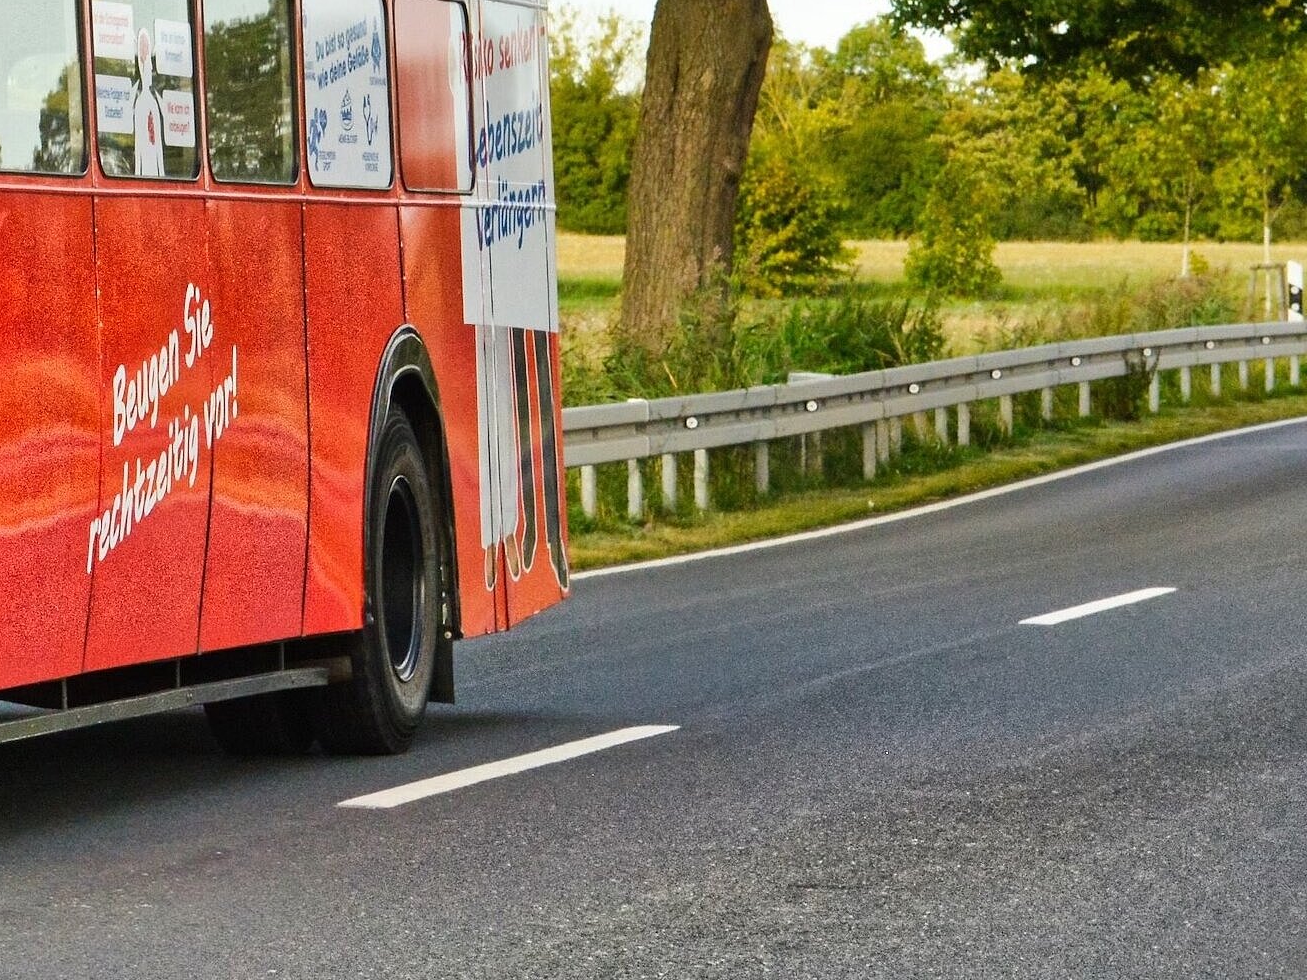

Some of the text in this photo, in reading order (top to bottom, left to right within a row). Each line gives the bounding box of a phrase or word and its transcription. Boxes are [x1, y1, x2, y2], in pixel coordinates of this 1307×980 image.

[329, 60, 347, 84] deine
[499, 14, 537, 71] senken
[112, 281, 214, 447] Beugen Sie
[85, 343, 238, 575] rechtzeitig vor!
